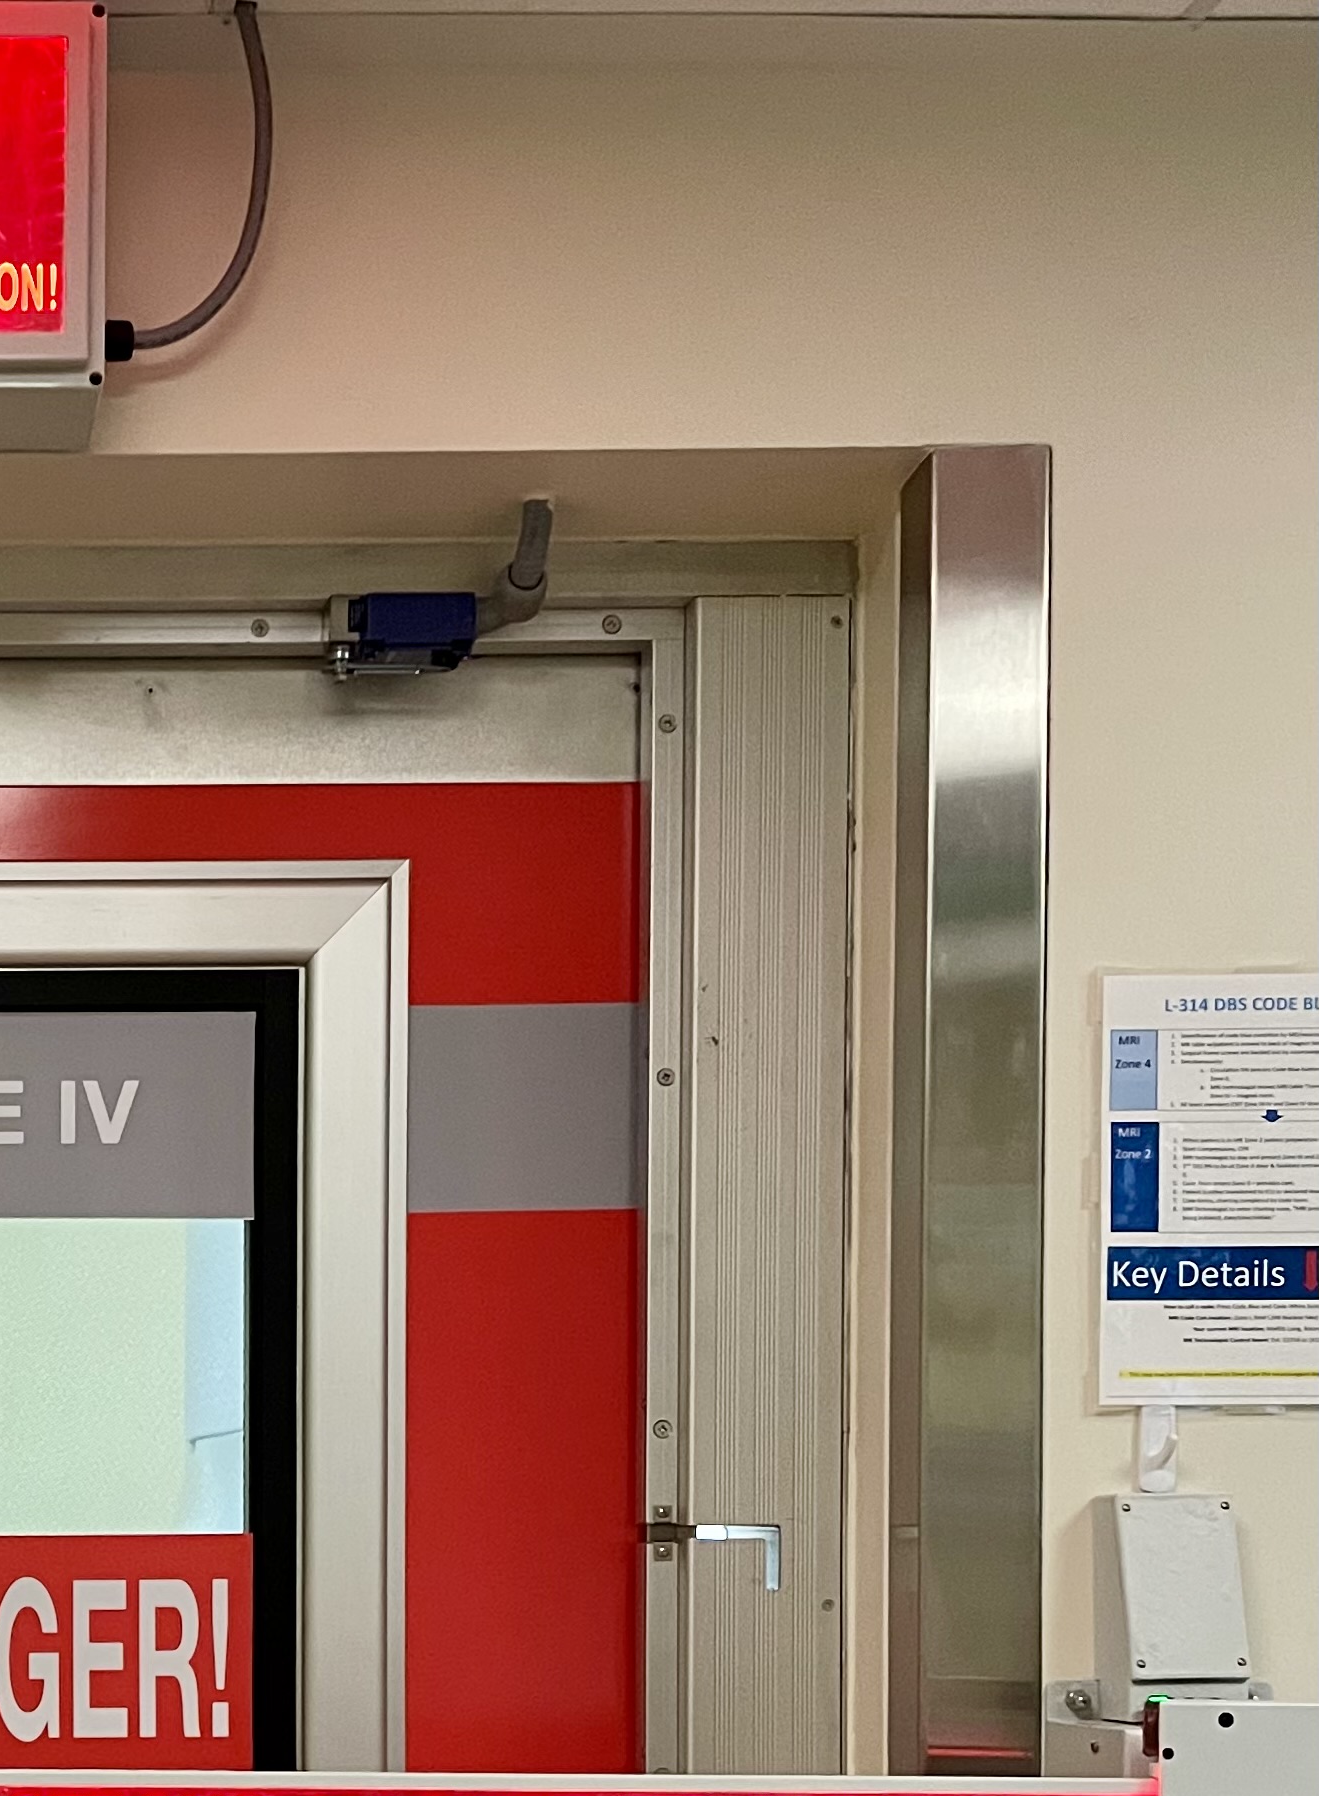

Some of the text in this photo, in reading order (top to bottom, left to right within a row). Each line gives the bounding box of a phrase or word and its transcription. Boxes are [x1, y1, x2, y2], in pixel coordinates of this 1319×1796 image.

[1165, 998, 1208, 1012] L-314
[1214, 997, 1247, 1011] DBS
[1252, 997, 1298, 1011] CODE
[1118, 1035, 1141, 1045] MRI
[1115, 1058, 1151, 1069] Zone 4
[60, 1079, 140, 1145] IV
[1118, 1127, 1141, 1138] MRI
[1115, 1148, 1152, 1160] Zone 2
[1113, 1258, 1285, 1294] Key Details
